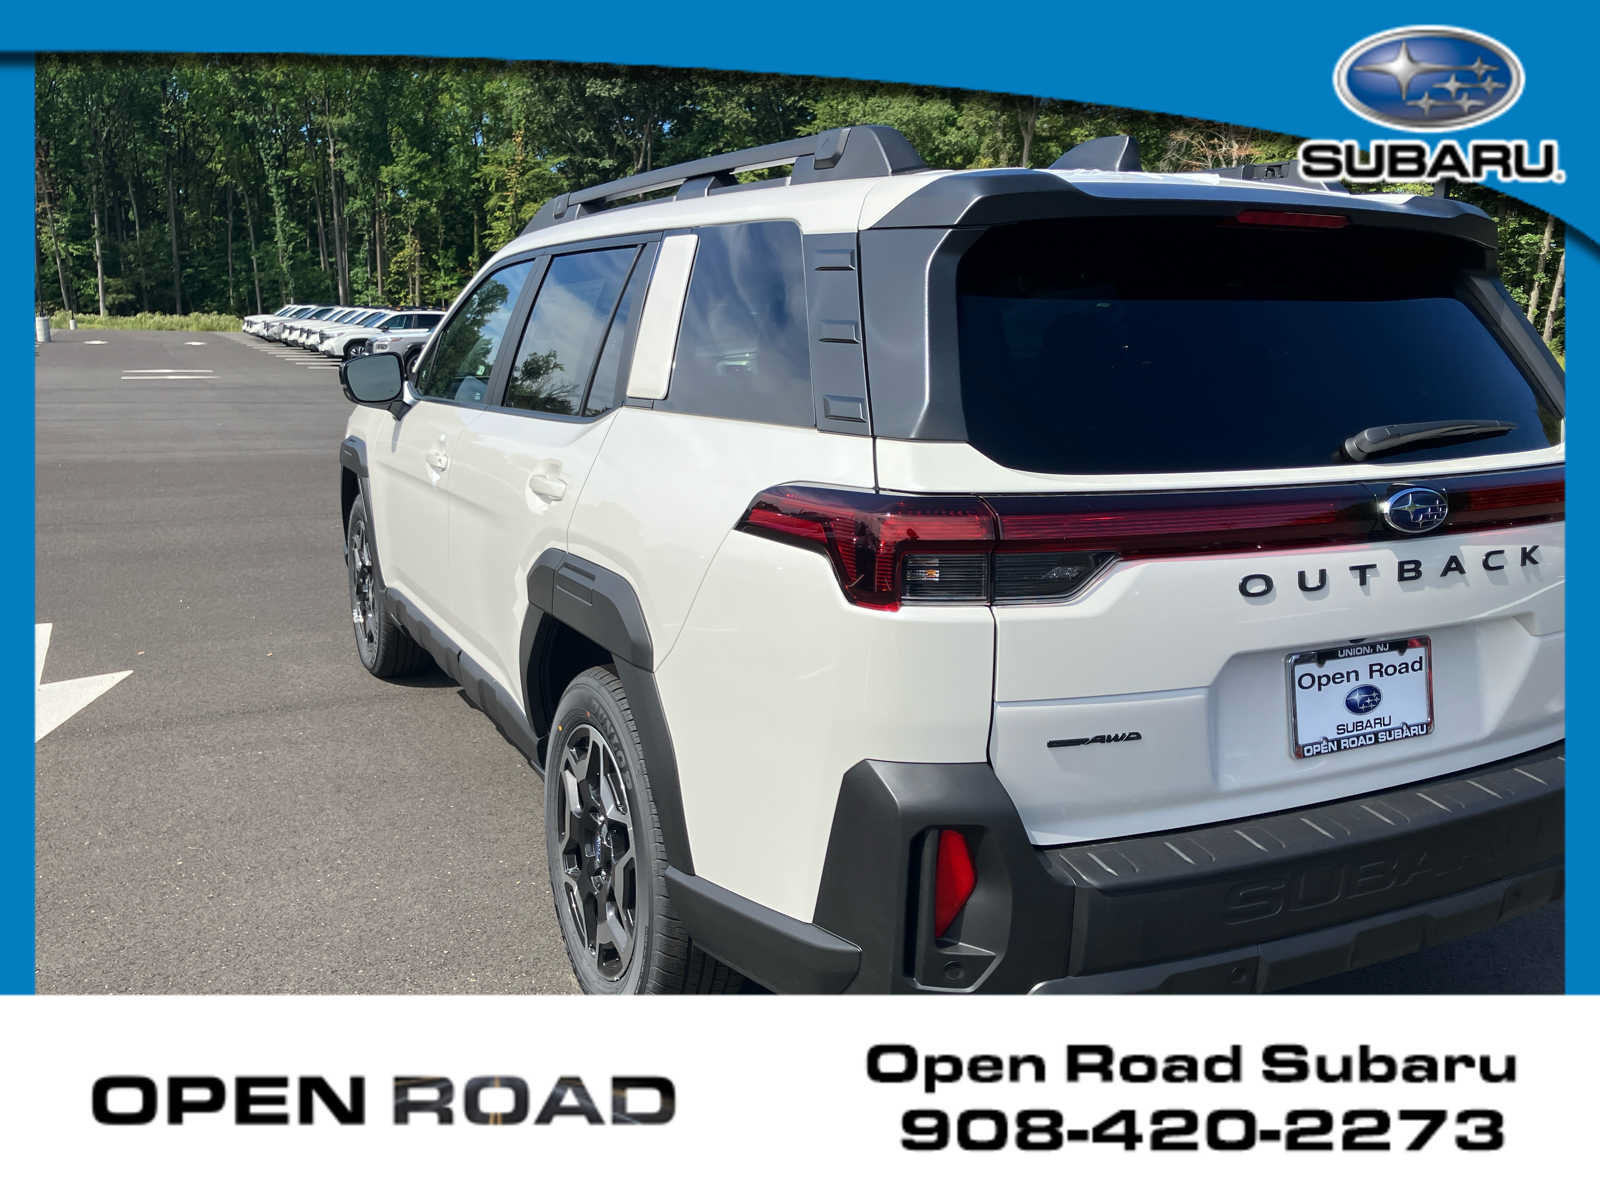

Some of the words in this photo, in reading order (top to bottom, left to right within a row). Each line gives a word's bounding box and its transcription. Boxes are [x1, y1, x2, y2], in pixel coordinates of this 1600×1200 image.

[1238, 545, 1540, 597] OUTBACK
[1338, 645, 1373, 658] UNION,
[1376, 642, 1389, 652] NJ
[1297, 669, 1360, 692] Open
[1368, 656, 1423, 679] Road
[1304, 741, 1338, 757] OPEN
[1340, 735, 1375, 749] ROAD
[1379, 724, 1427, 742] SUBARU
[1336, 715, 1392, 735] SUBARU
